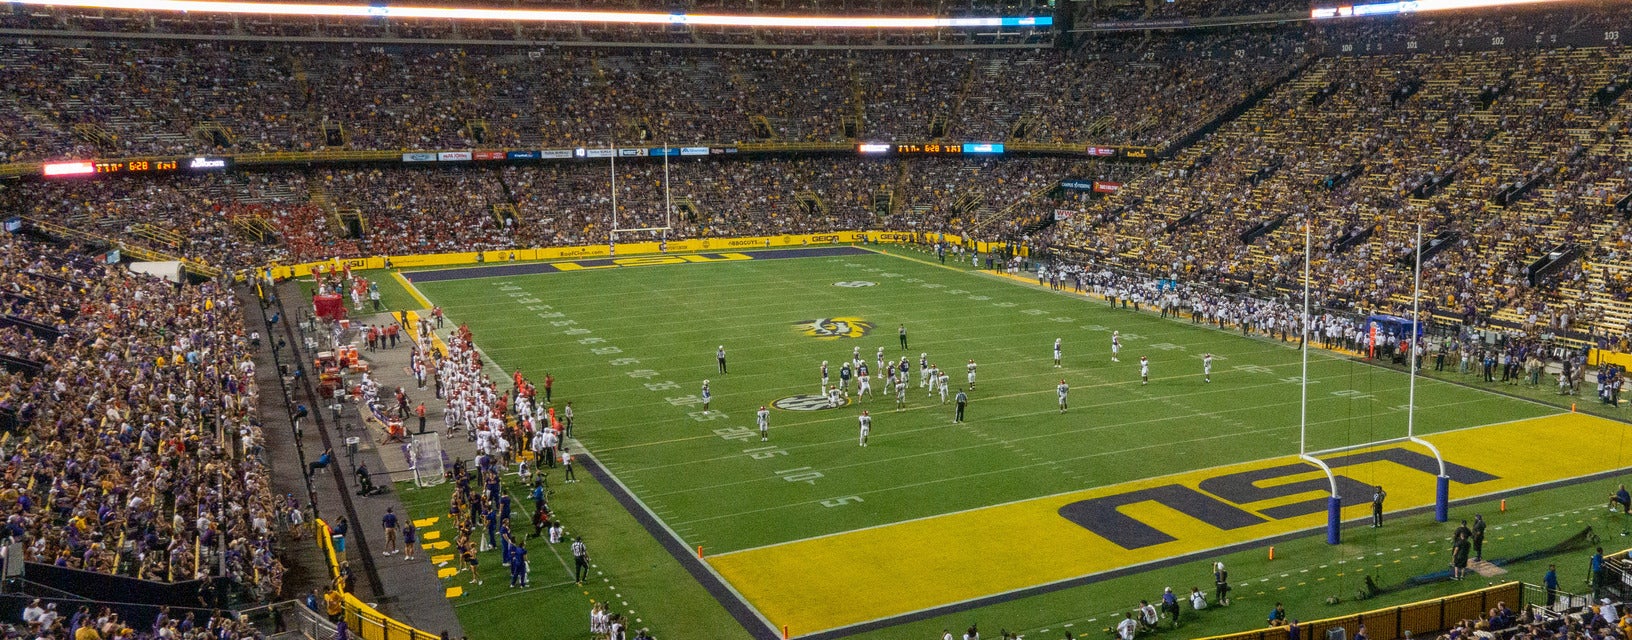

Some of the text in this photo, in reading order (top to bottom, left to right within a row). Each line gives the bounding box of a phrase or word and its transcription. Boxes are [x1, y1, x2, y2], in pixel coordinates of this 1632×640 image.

[1491, 36, 1504, 46] 102
[1604, 31, 1619, 41] 103
[1342, 44, 1353, 52] 100
[1406, 41, 1418, 49] 101
[924, 144, 940, 152] 6:28
[129, 161, 148, 171] 6:28
[811, 235, 839, 243] GEICO
[712, 426, 758, 441] 20
[742, 445, 790, 460] 15
[774, 466, 825, 483] 10
[819, 495, 865, 508] 5
[1057, 447, 1503, 551] LSU
